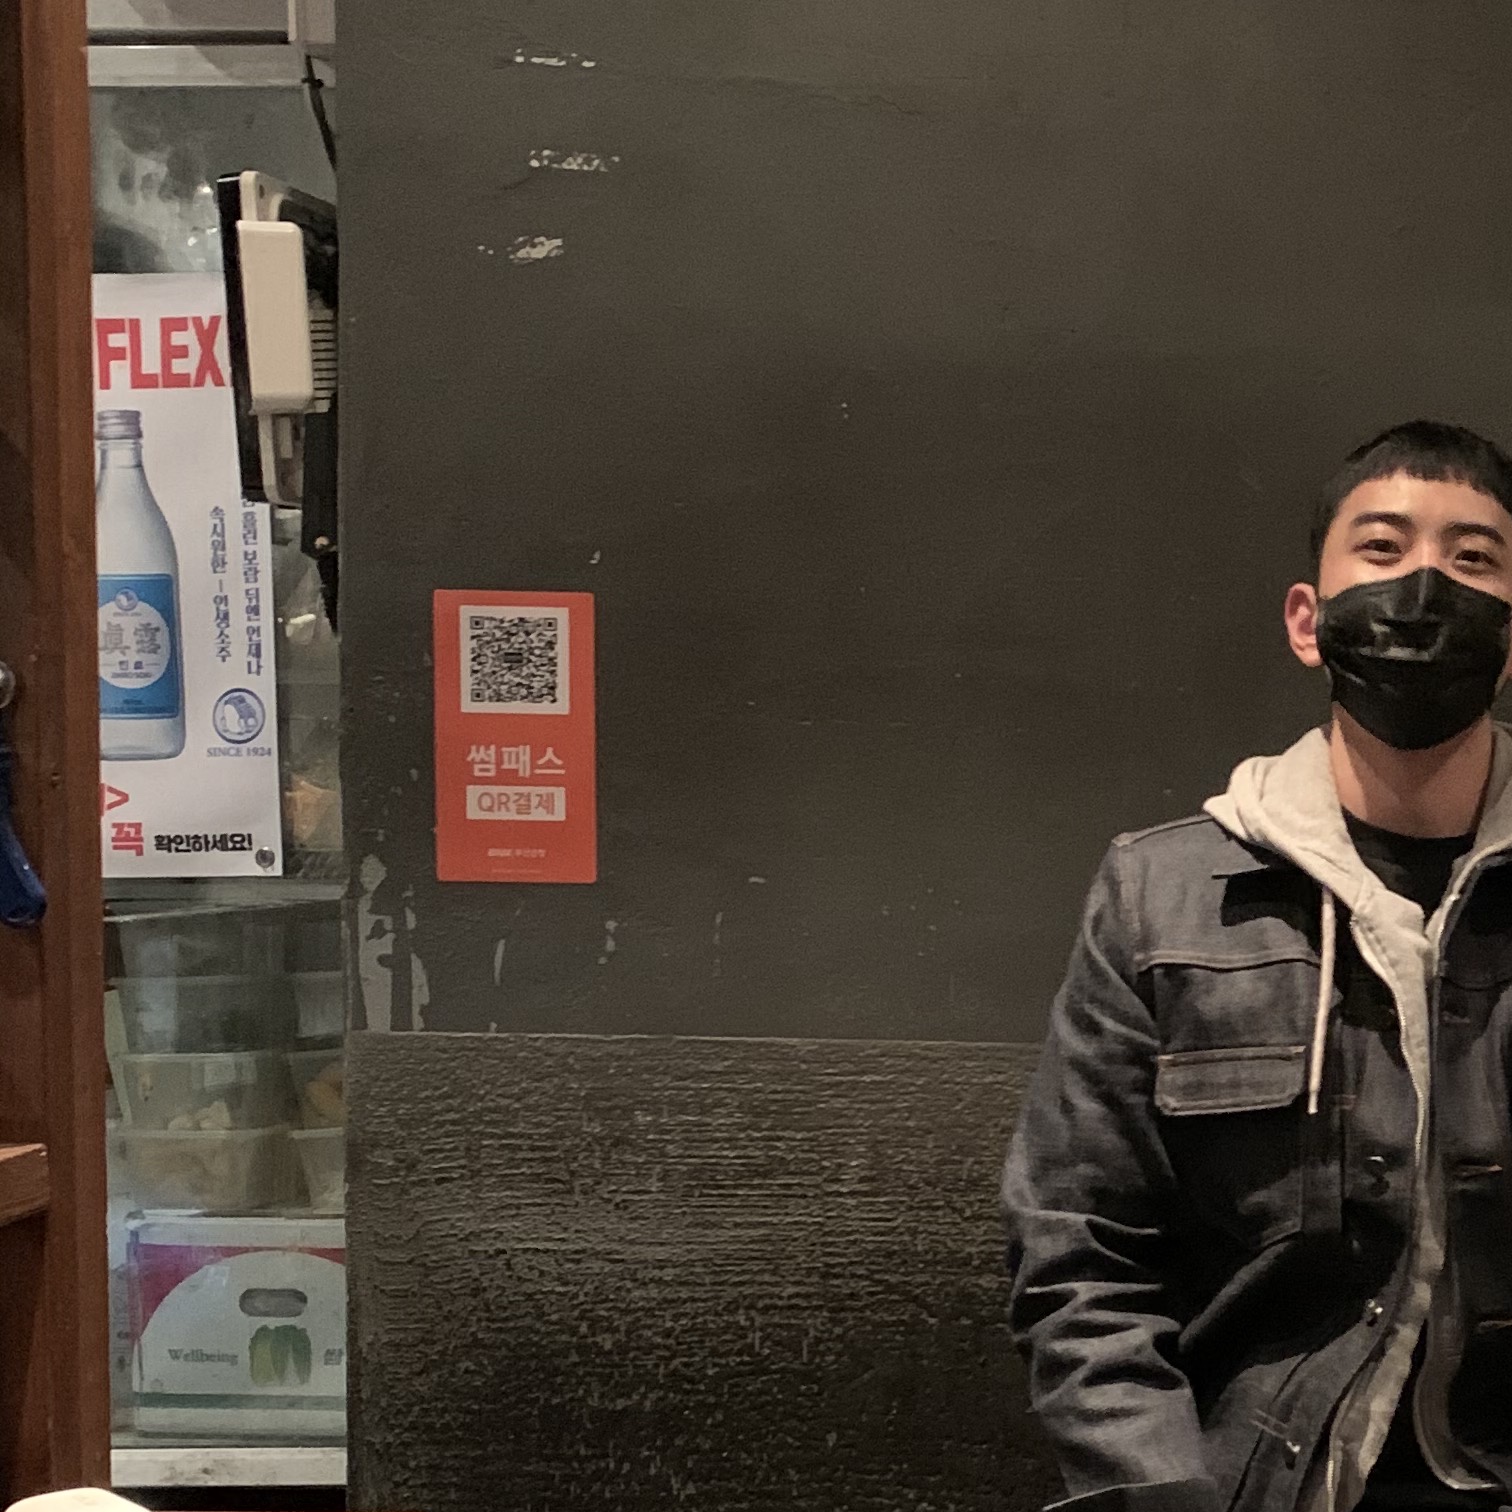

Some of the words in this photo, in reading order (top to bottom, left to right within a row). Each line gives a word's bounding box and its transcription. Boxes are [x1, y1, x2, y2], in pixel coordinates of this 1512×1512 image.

[95, 315, 226, 390] FLEX
[207, 747, 243, 758] SINCE
[246, 747, 272, 758] 1924
[466, 744, 566, 778] 썸패스
[477, 792, 556, 815] QR결제
[111, 822, 144, 857] 꼭
[154, 833, 253, 853] 확인하세요!
